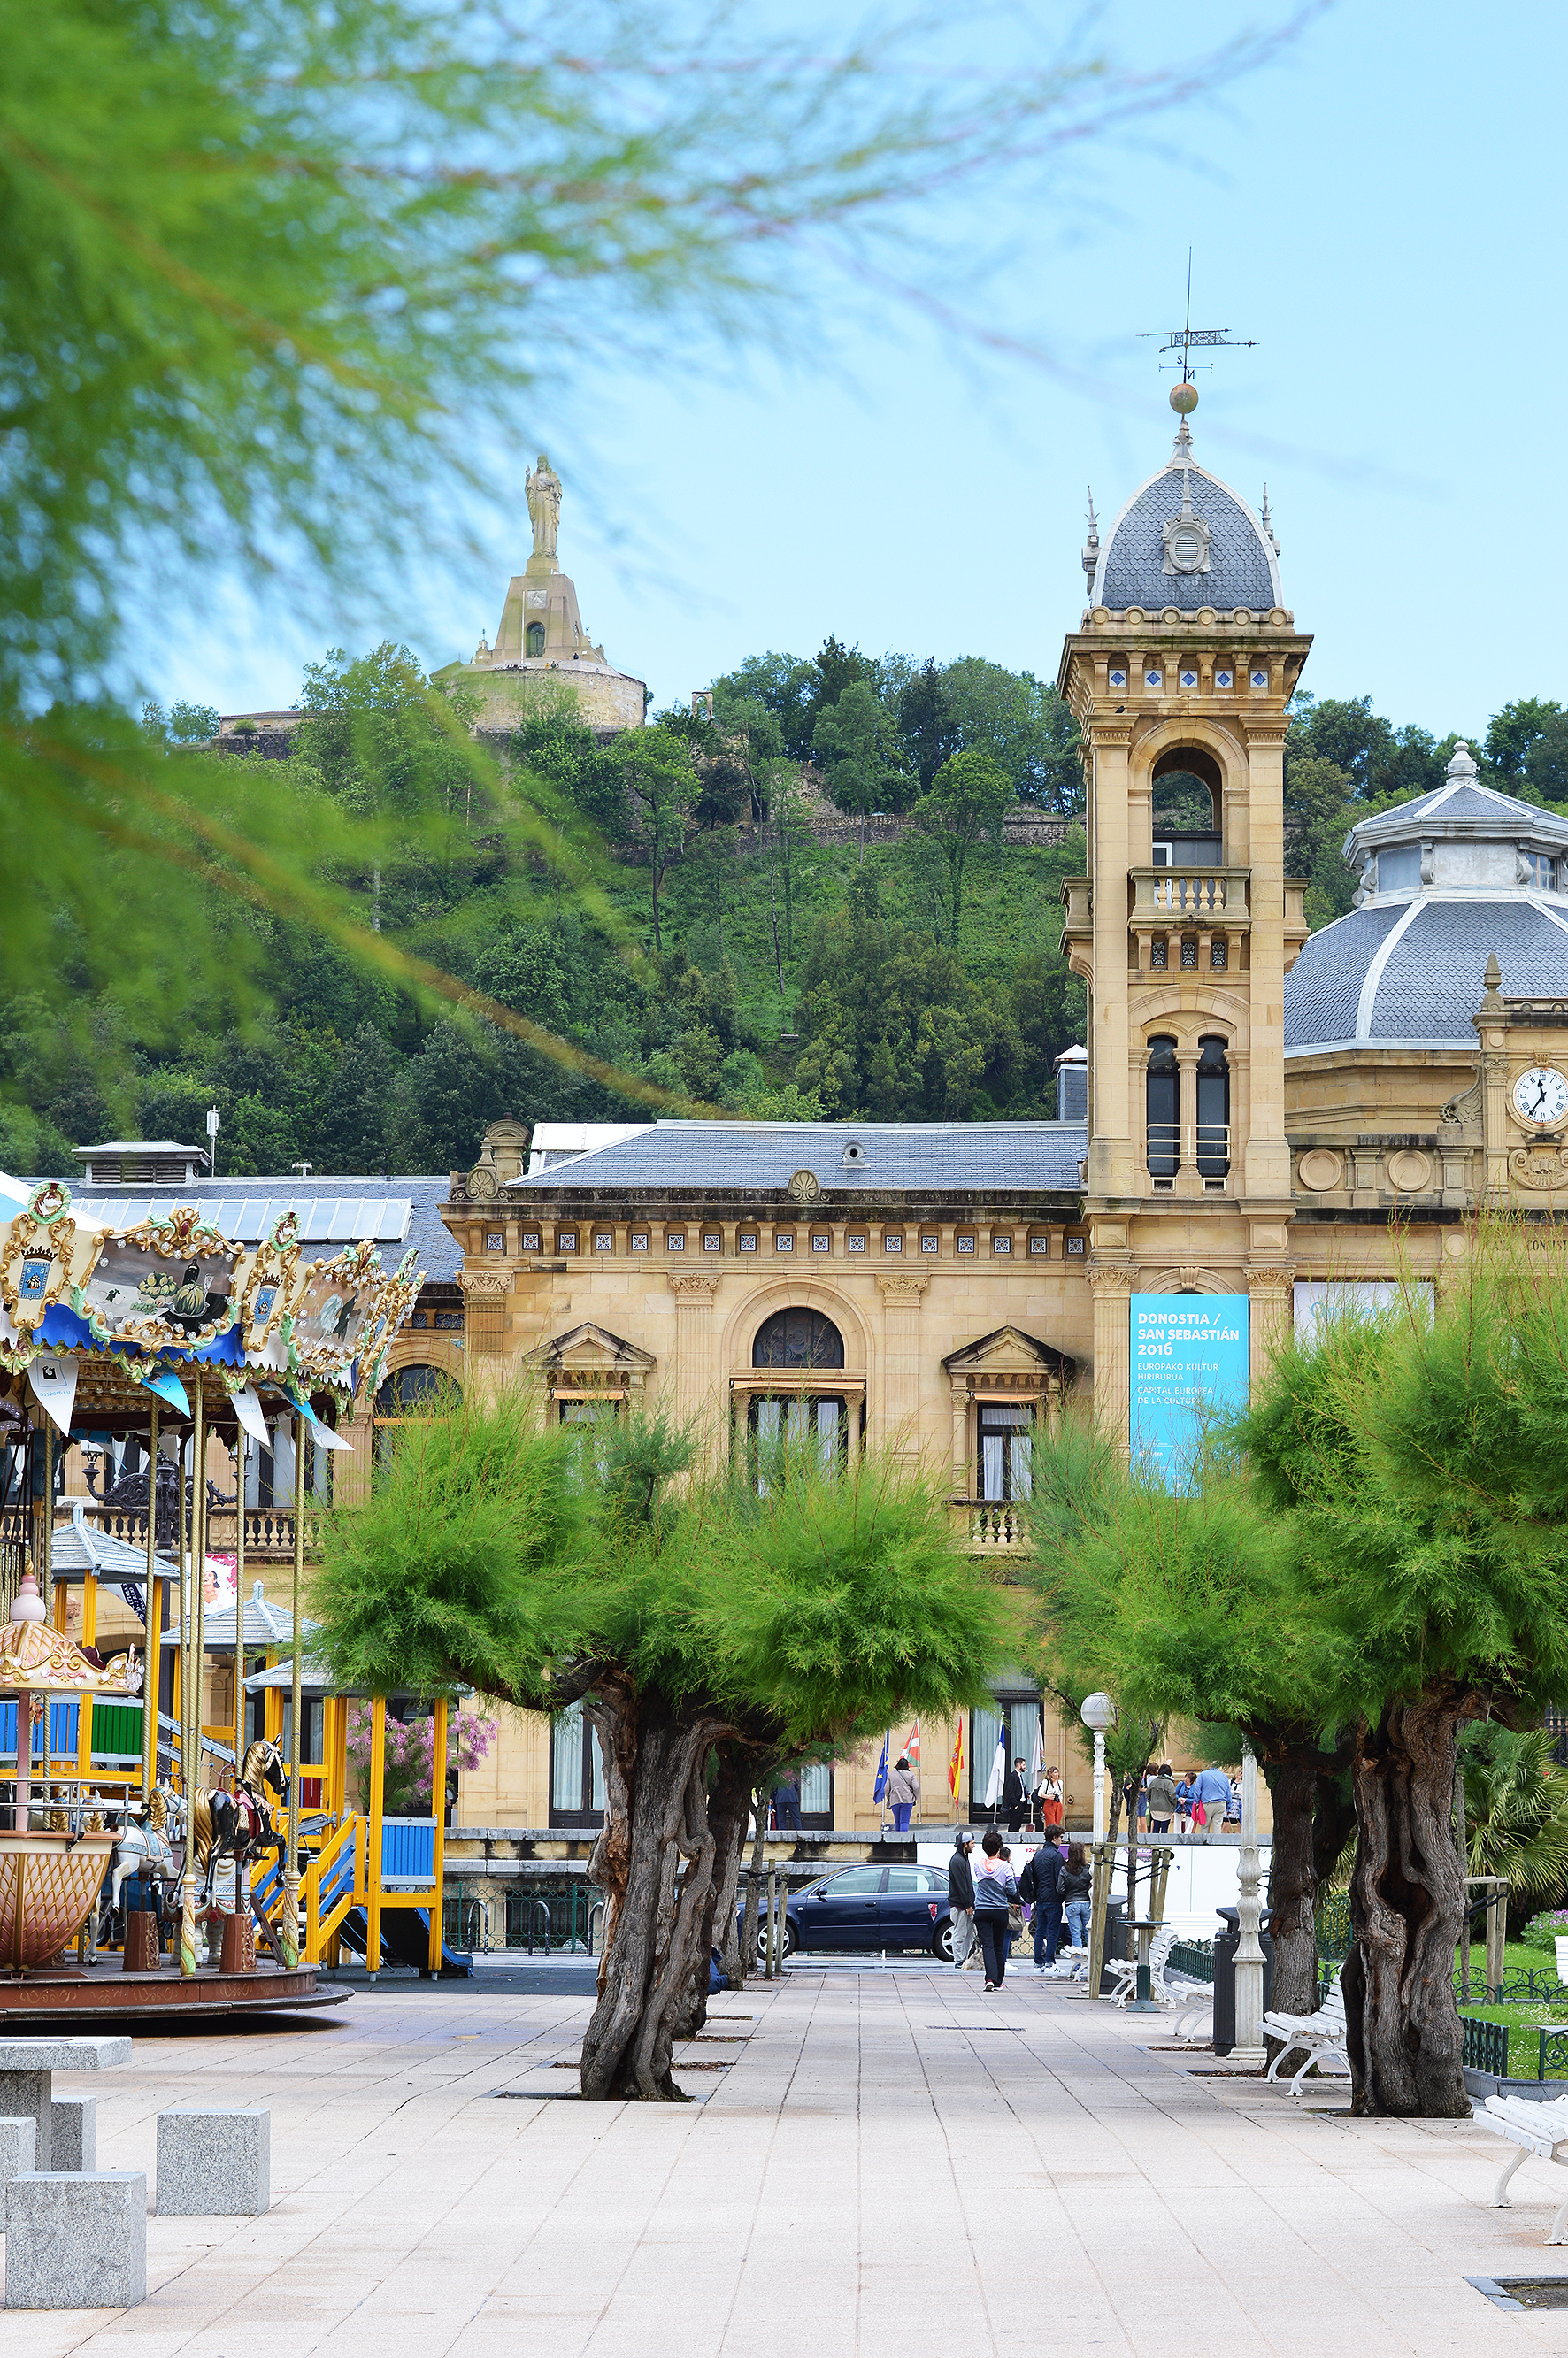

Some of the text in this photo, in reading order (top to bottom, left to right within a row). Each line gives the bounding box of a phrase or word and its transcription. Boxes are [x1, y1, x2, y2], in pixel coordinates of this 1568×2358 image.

[1138, 1313, 1210, 1324] DONOSTIA
[1138, 1326, 1239, 1340] SAN SEBASTIÁN
[1138, 1342, 1173, 1355] 2016
